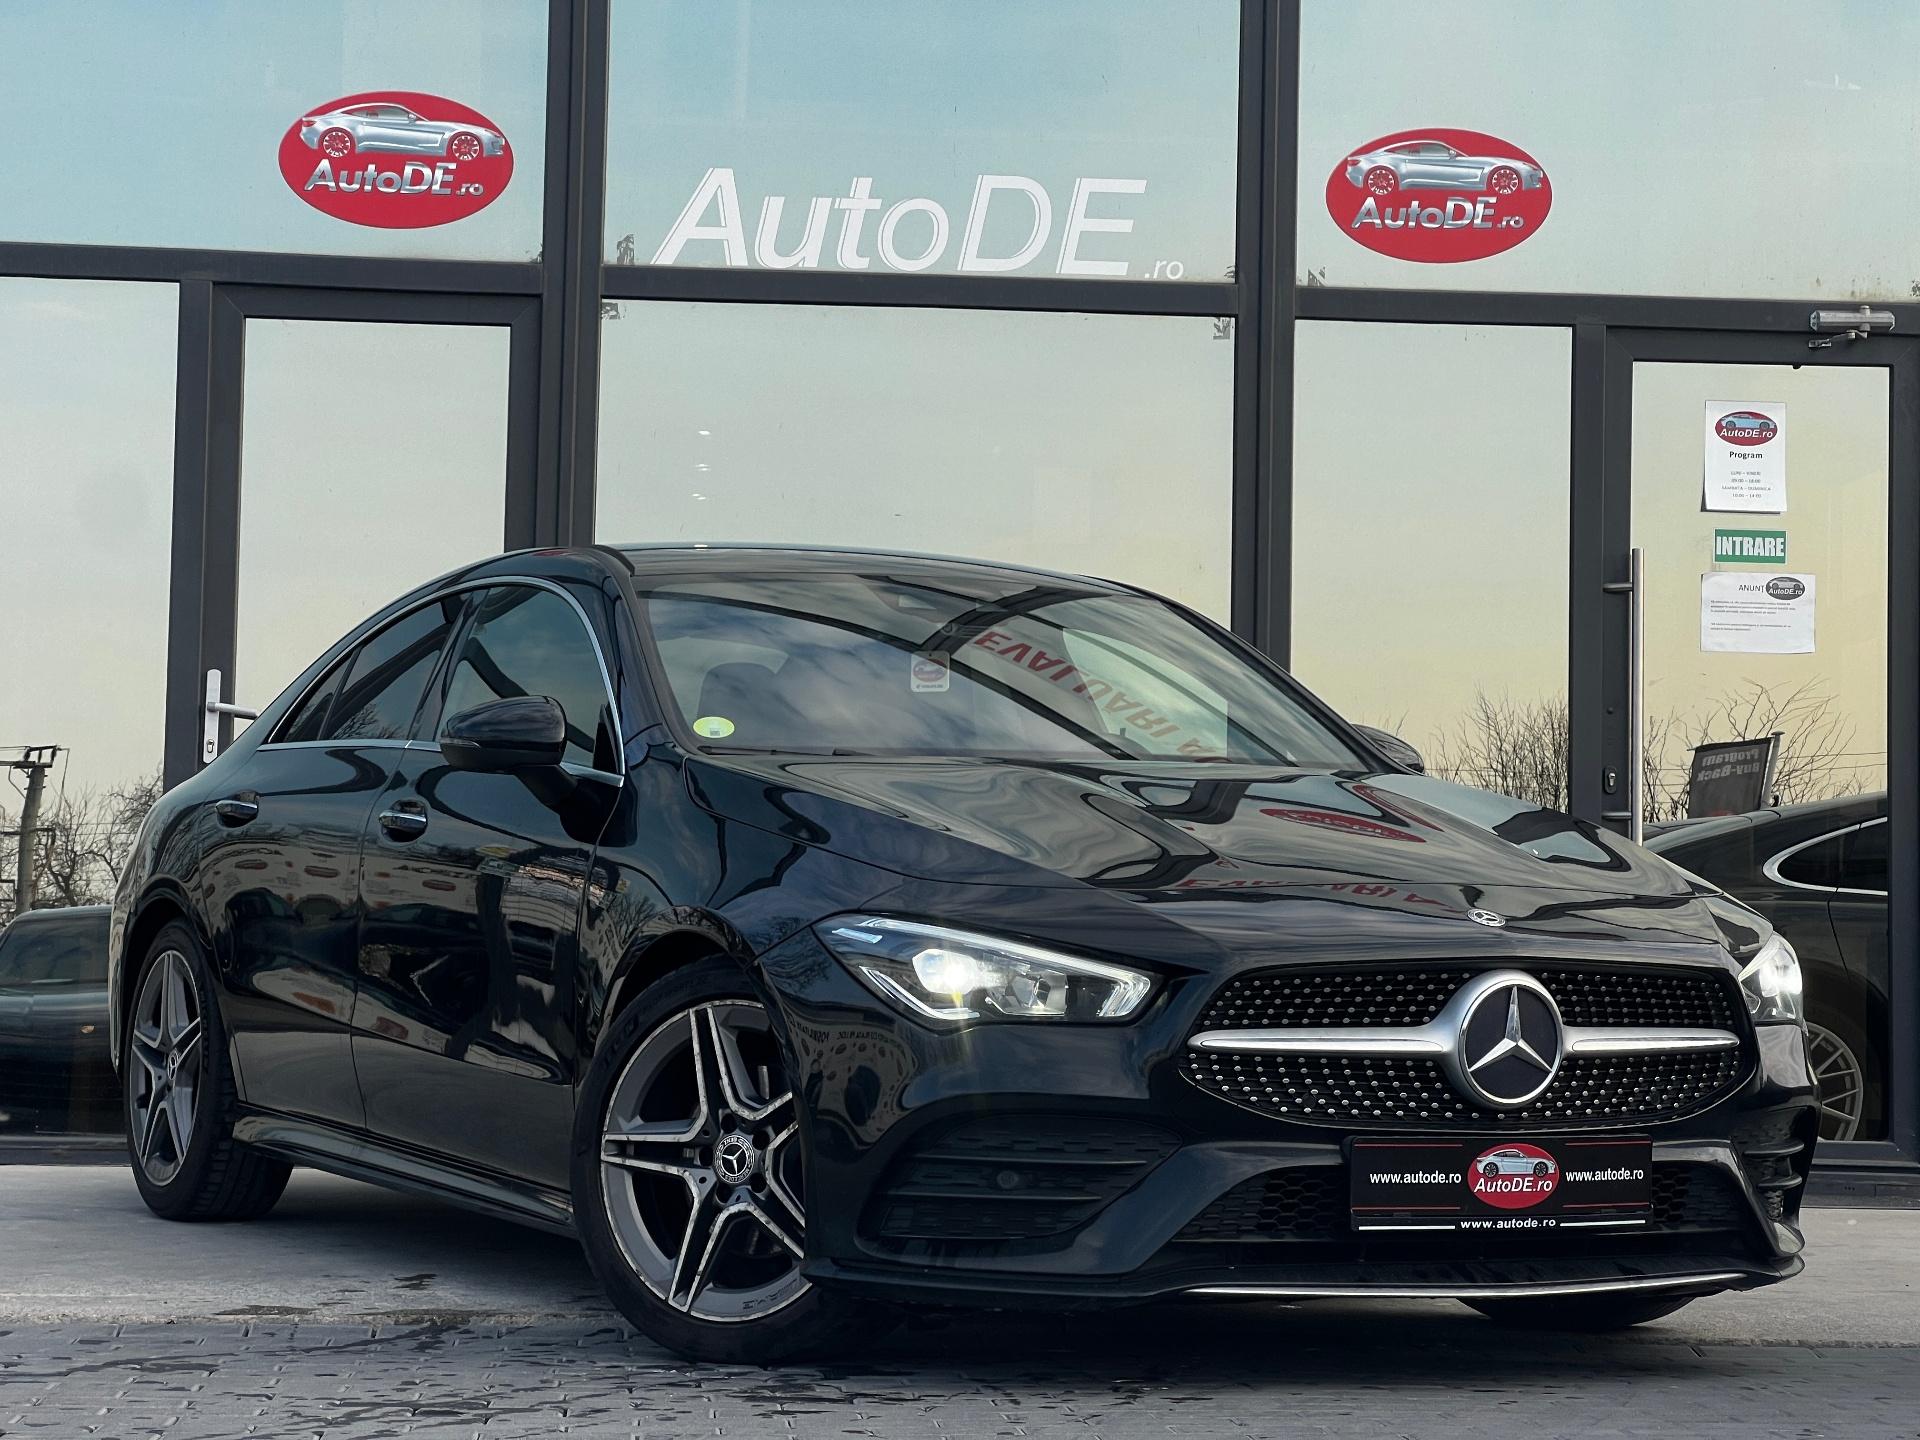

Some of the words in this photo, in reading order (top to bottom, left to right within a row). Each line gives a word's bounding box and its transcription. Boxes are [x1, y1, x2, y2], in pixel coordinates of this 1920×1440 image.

[1720, 428, 1773, 438] AutoDE.ro
[1729, 451, 1763, 460] Program
[1716, 536, 1785, 557] INTRARE
[1370, 1170, 1462, 1184] www.autode.ro
[1566, 1169, 1644, 1182] www.autode.ro
[1474, 1177, 1553, 1193] AutoDE.ro
[1460, 1218, 1556, 1229] www.autode.ro
